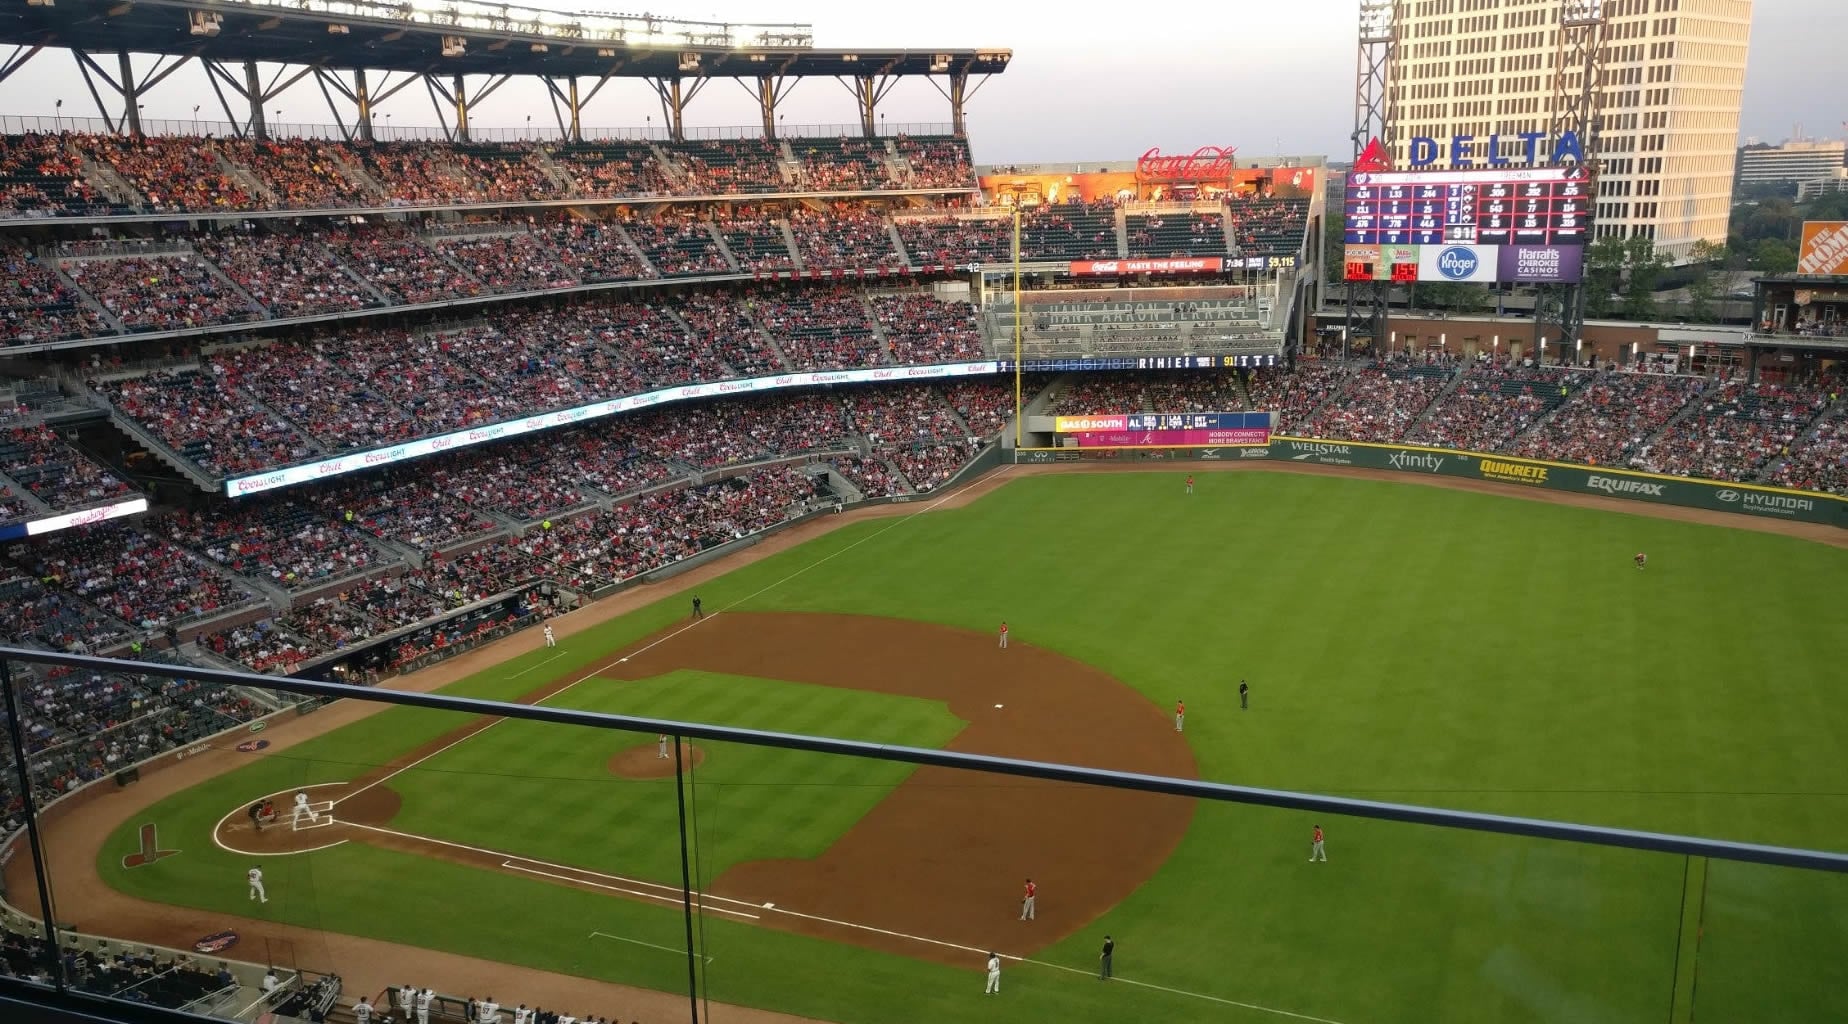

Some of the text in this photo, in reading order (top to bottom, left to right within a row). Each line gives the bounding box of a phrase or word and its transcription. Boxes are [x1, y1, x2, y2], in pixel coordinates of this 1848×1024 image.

[1411, 131, 1584, 166] DELTA
[1454, 227, 1469, 238] 91
[1808, 228, 1832, 250] THE
[1518, 248, 1560, 260] Harrah's
[968, 263, 980, 272] 42
[1126, 261, 1151, 270] TASTE
[1170, 259, 1204, 268] FEELING
[1348, 263, 1363, 274] 40
[1442, 252, 1475, 276] Kroger
[1050, 301, 1248, 324] HANK AARON TERRACE
[1054, 360, 1064, 370] 4
[1082, 359, 1091, 369] 6
[1140, 358, 1146, 368] R
[1158, 358, 1164, 368] H
[1176, 358, 1181, 368] E
[1224, 356, 1233, 366] 91
[1061, 419, 1122, 429] GAS SOUTH
[1129, 419, 1141, 428] AL
[238, 480, 263, 491] Coors
[264, 475, 285, 486] LIGHT
[319, 463, 342, 473] Chill
[365, 449, 388, 463] Coors
[388, 448, 405, 459] LIGHT
[432, 439, 450, 449] Chill
[526, 419, 543, 429] Chill
[682, 388, 700, 396] Chill
[776, 376, 793, 385] Chill
[1291, 442, 1350, 454] WELLSTAR
[1389, 451, 1444, 472] xfinity
[1480, 460, 1548, 478] QUIKRETE
[1587, 475, 1664, 496] EQUIFAX
[1743, 493, 1813, 511] HYUNDAI
